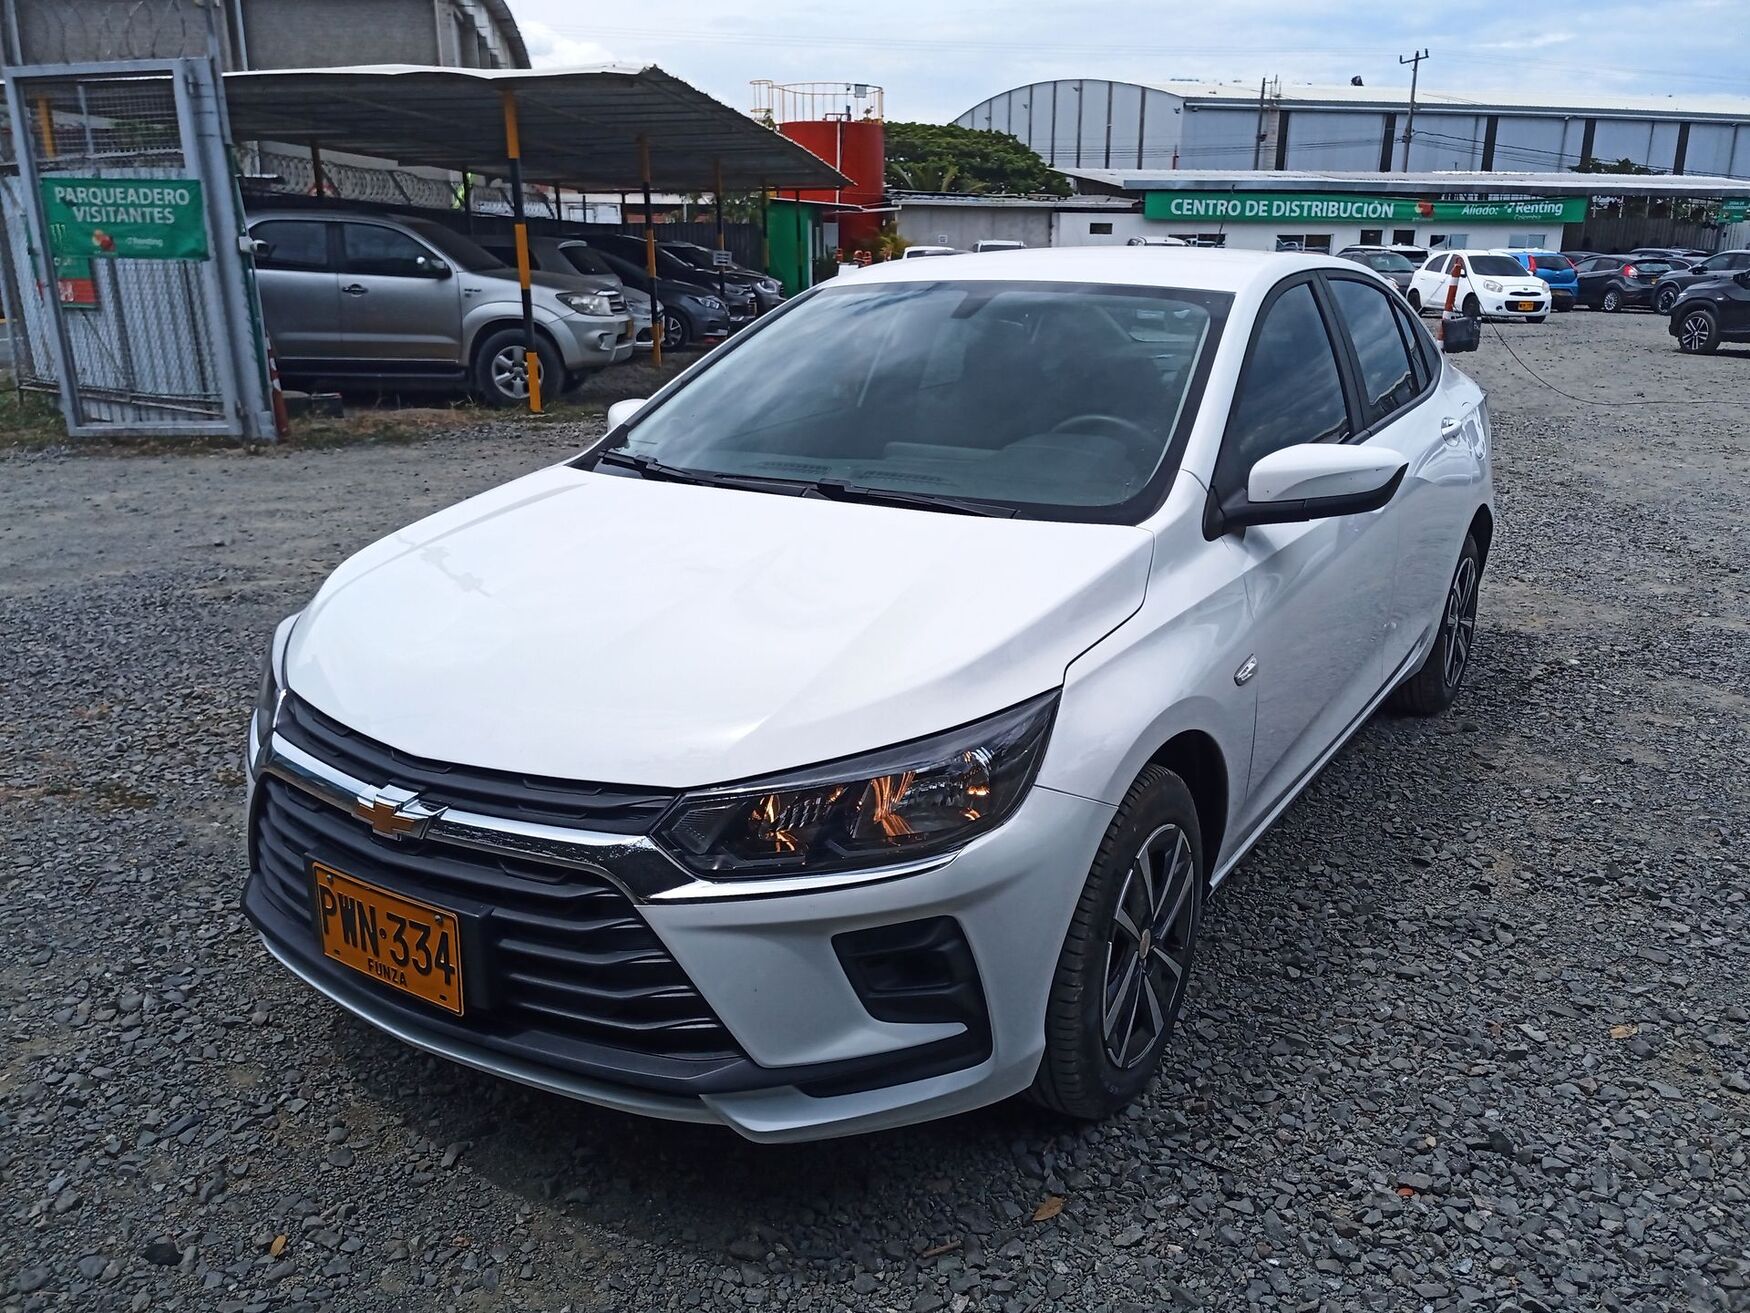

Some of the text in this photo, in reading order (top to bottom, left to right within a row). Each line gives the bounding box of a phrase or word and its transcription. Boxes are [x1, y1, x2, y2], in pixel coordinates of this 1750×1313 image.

[54, 186, 190, 206] PARQUEADERO
[72, 206, 175, 224] VISITANTES
[1170, 198, 1395, 218] CENTRO DE DISTRIBUCIÓN
[1461, 203, 1499, 216] Aliado:
[1515, 201, 1564, 216] Renting
[367, 957, 408, 987] FUNZA
